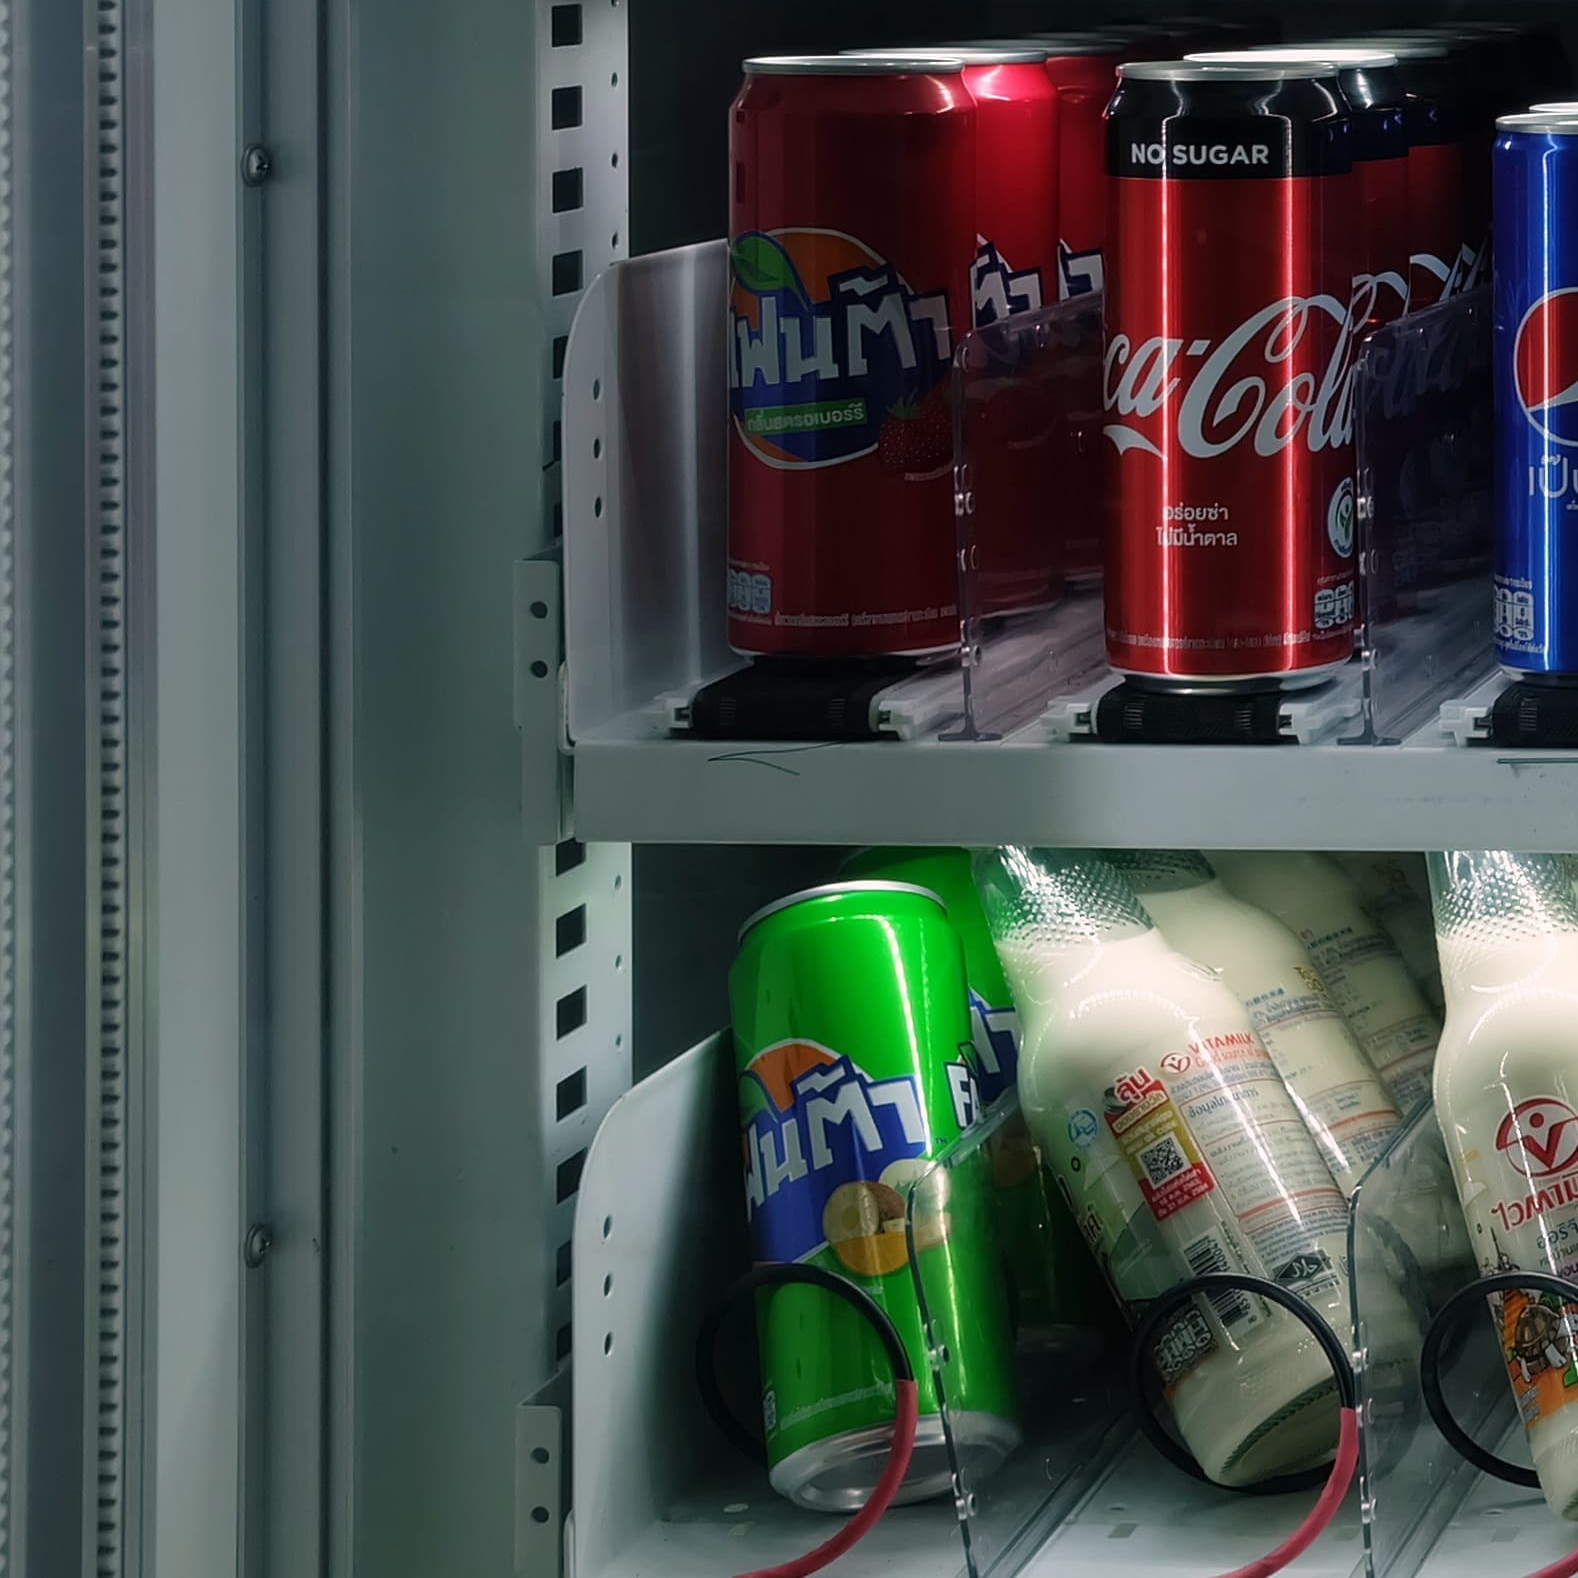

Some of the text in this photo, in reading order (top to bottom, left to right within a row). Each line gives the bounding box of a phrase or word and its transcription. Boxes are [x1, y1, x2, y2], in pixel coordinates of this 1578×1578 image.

[1131, 142, 1269, 165] NO SUGAR
[1103, 295, 1354, 459] ca-Cola
[1163, 502, 1229, 522] อร่อยซ่า
[1156, 521, 1238, 547] ไม่มีน้ำตาล
